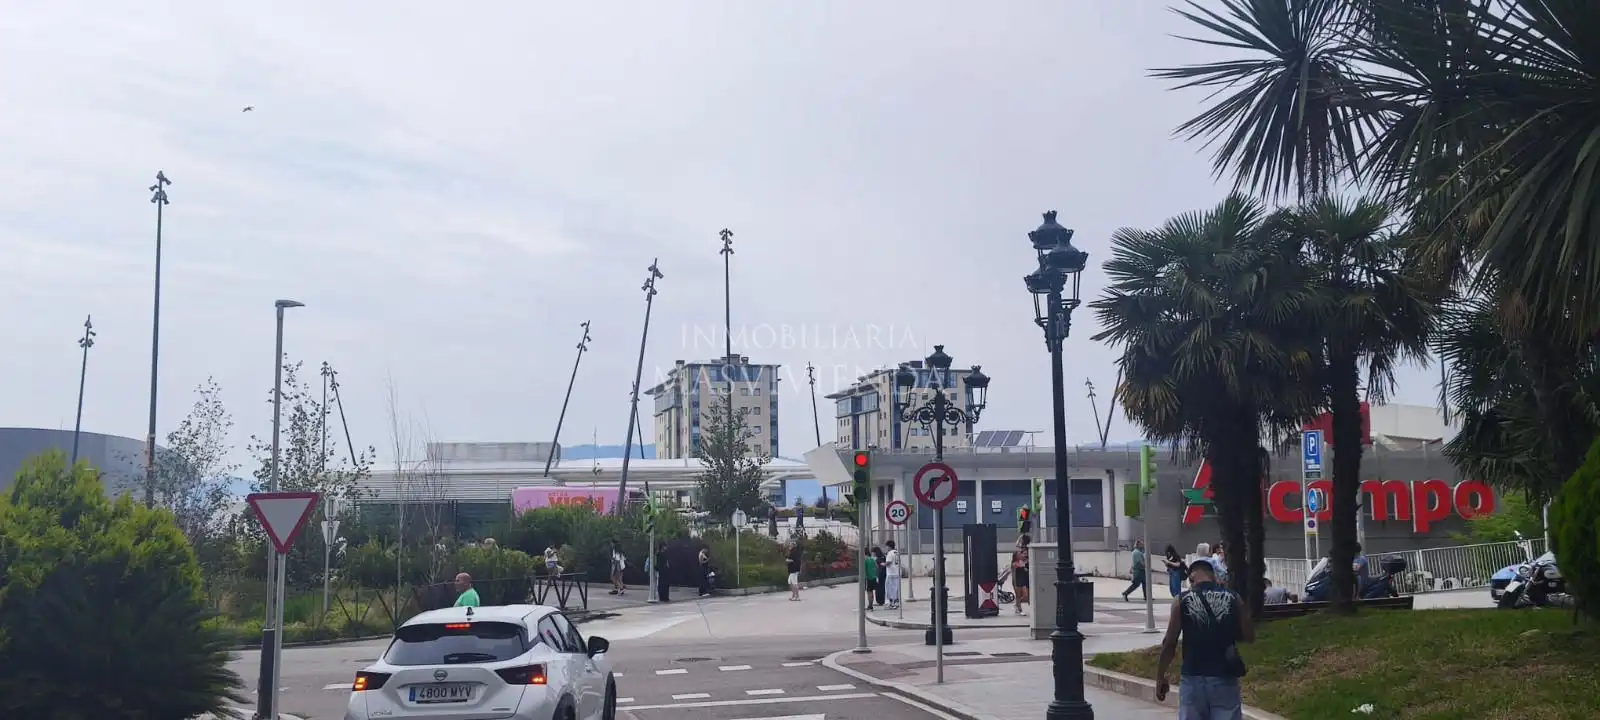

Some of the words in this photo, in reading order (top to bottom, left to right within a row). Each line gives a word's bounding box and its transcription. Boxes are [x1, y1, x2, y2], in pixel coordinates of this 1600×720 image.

[1309, 436, 1316, 452] P
[891, 508, 905, 518] 20
[419, 687, 447, 699] 4800
[450, 686, 471, 698] MYV
